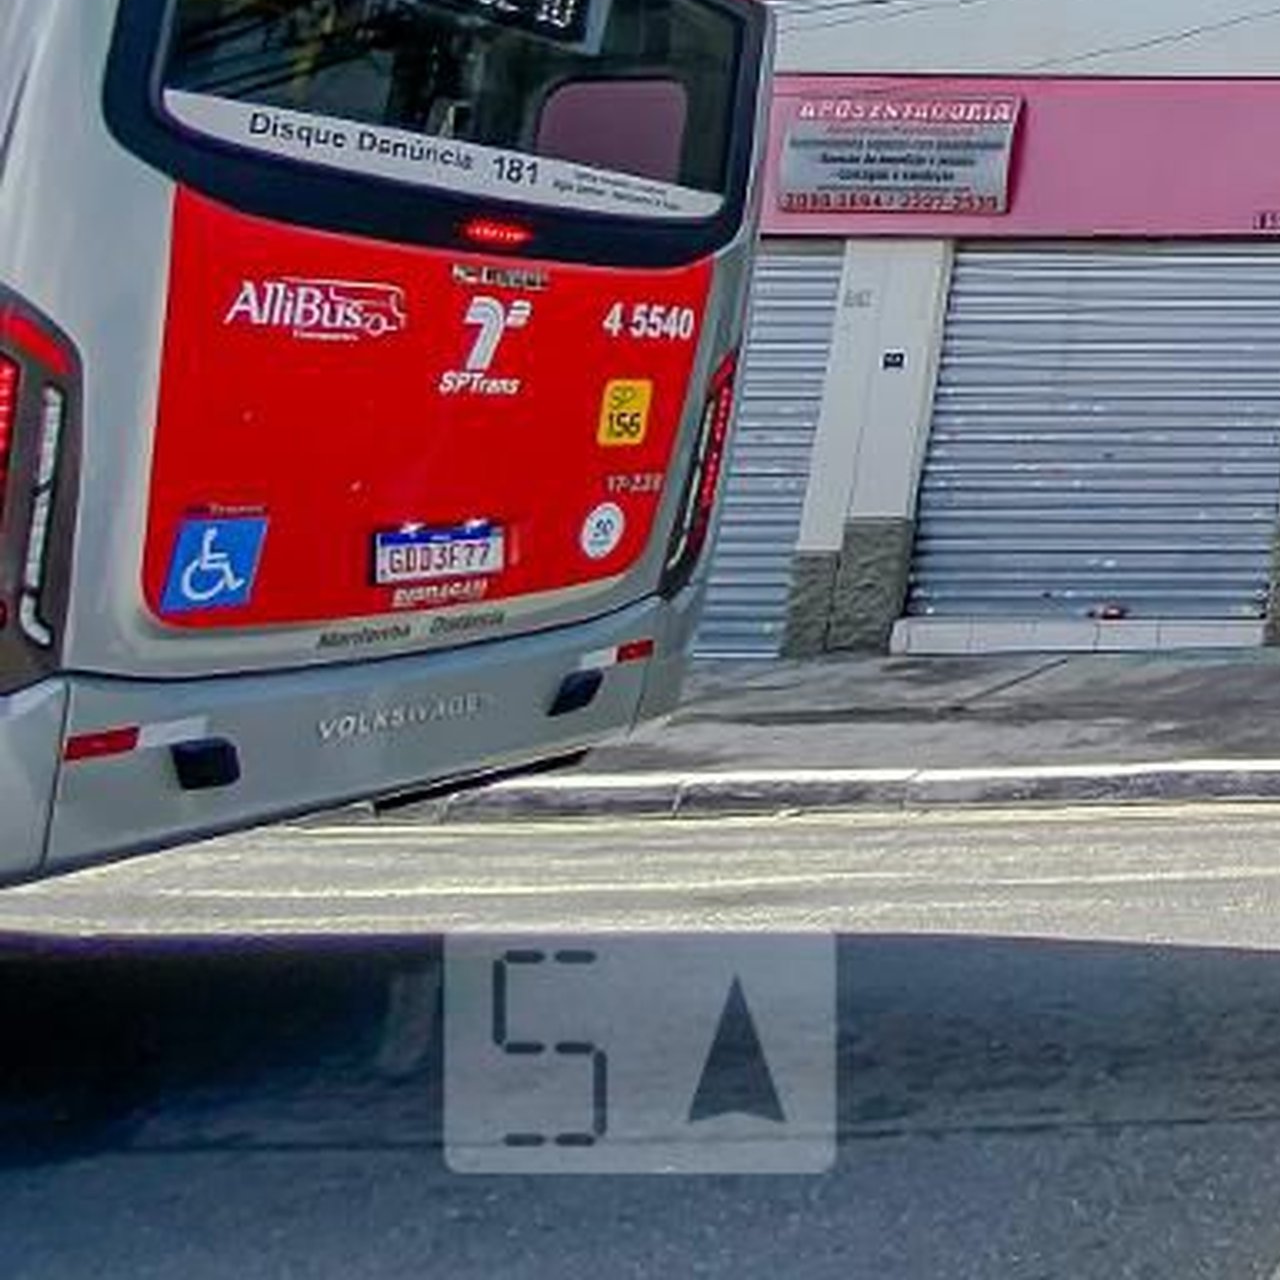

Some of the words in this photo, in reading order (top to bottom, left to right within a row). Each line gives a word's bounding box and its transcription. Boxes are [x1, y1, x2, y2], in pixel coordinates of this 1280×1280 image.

[250, 113, 347, 148] Disque
[493, 155, 538, 185] 181
[223, 279, 363, 329] AlliBus
[603, 303, 623, 337] 4
[630, 304, 694, 340] 5540
[440, 371, 521, 395] SPTrans
